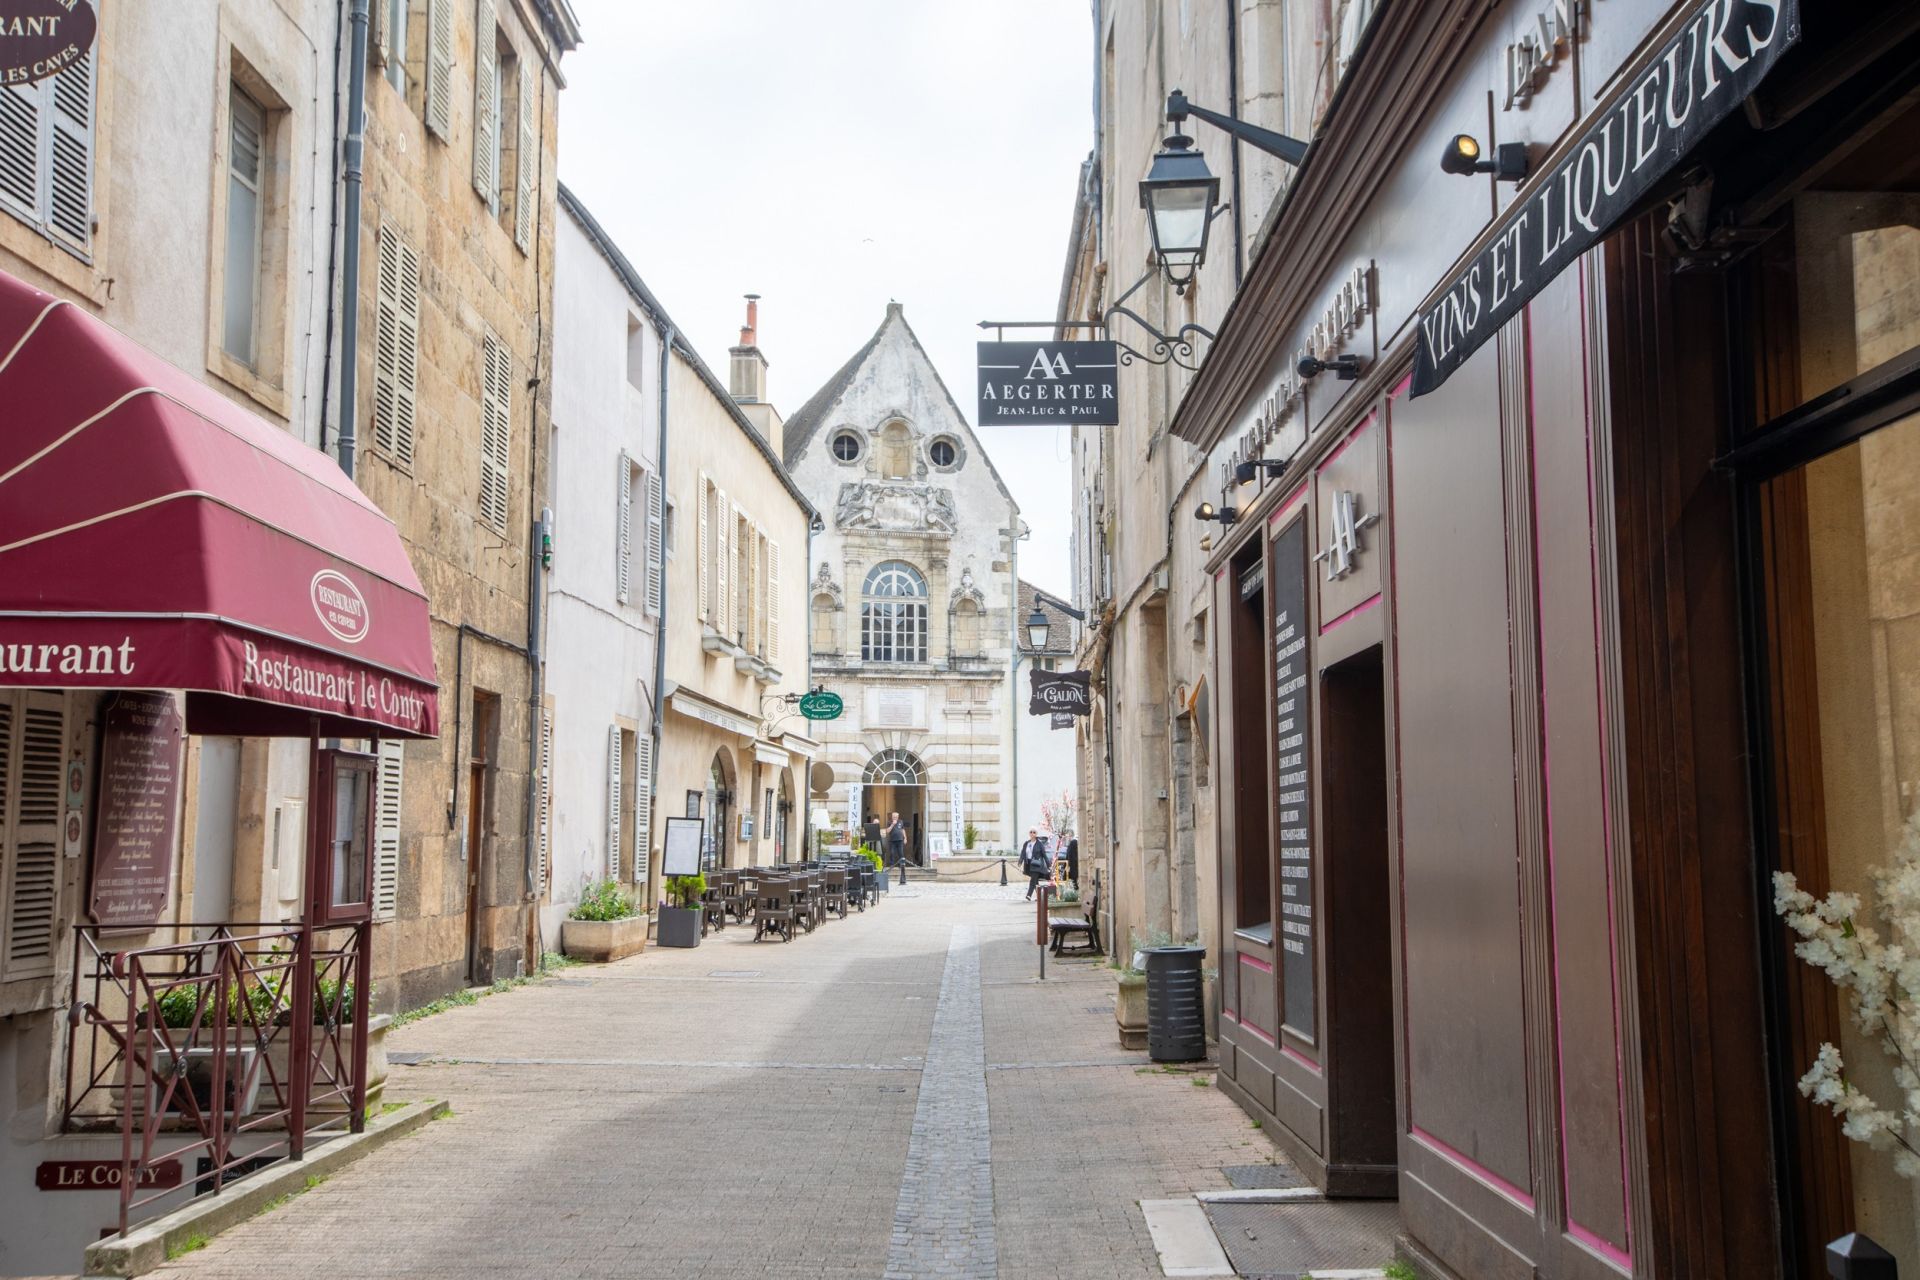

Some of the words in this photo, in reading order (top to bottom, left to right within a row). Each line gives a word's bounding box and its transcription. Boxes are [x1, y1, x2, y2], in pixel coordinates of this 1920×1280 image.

[33, 43, 79, 75] CAVES
[1423, 265, 1481, 369] VINS
[1489, 215, 1528, 313] ET
[1540, 0, 1781, 266] LIQUEURS
[1023, 347, 1072, 379] AA
[982, 381, 1114, 400] AEGERTER
[997, 405, 1055, 415] JEAN-LUC
[1058, 407, 1067, 415] &
[1071, 405, 1099, 415] PAUL
[318, 584, 362, 617] RESTAURANT
[329, 610, 337, 622] en
[243, 639, 356, 705] Restaurant
[361, 671, 376, 709] le
[380, 678, 425, 729] Conty
[803, 700, 815, 709] Le
[816, 699, 840, 711] Conty
[1043, 686, 1089, 705] GALION
[57, 1166, 85, 1184] LE
